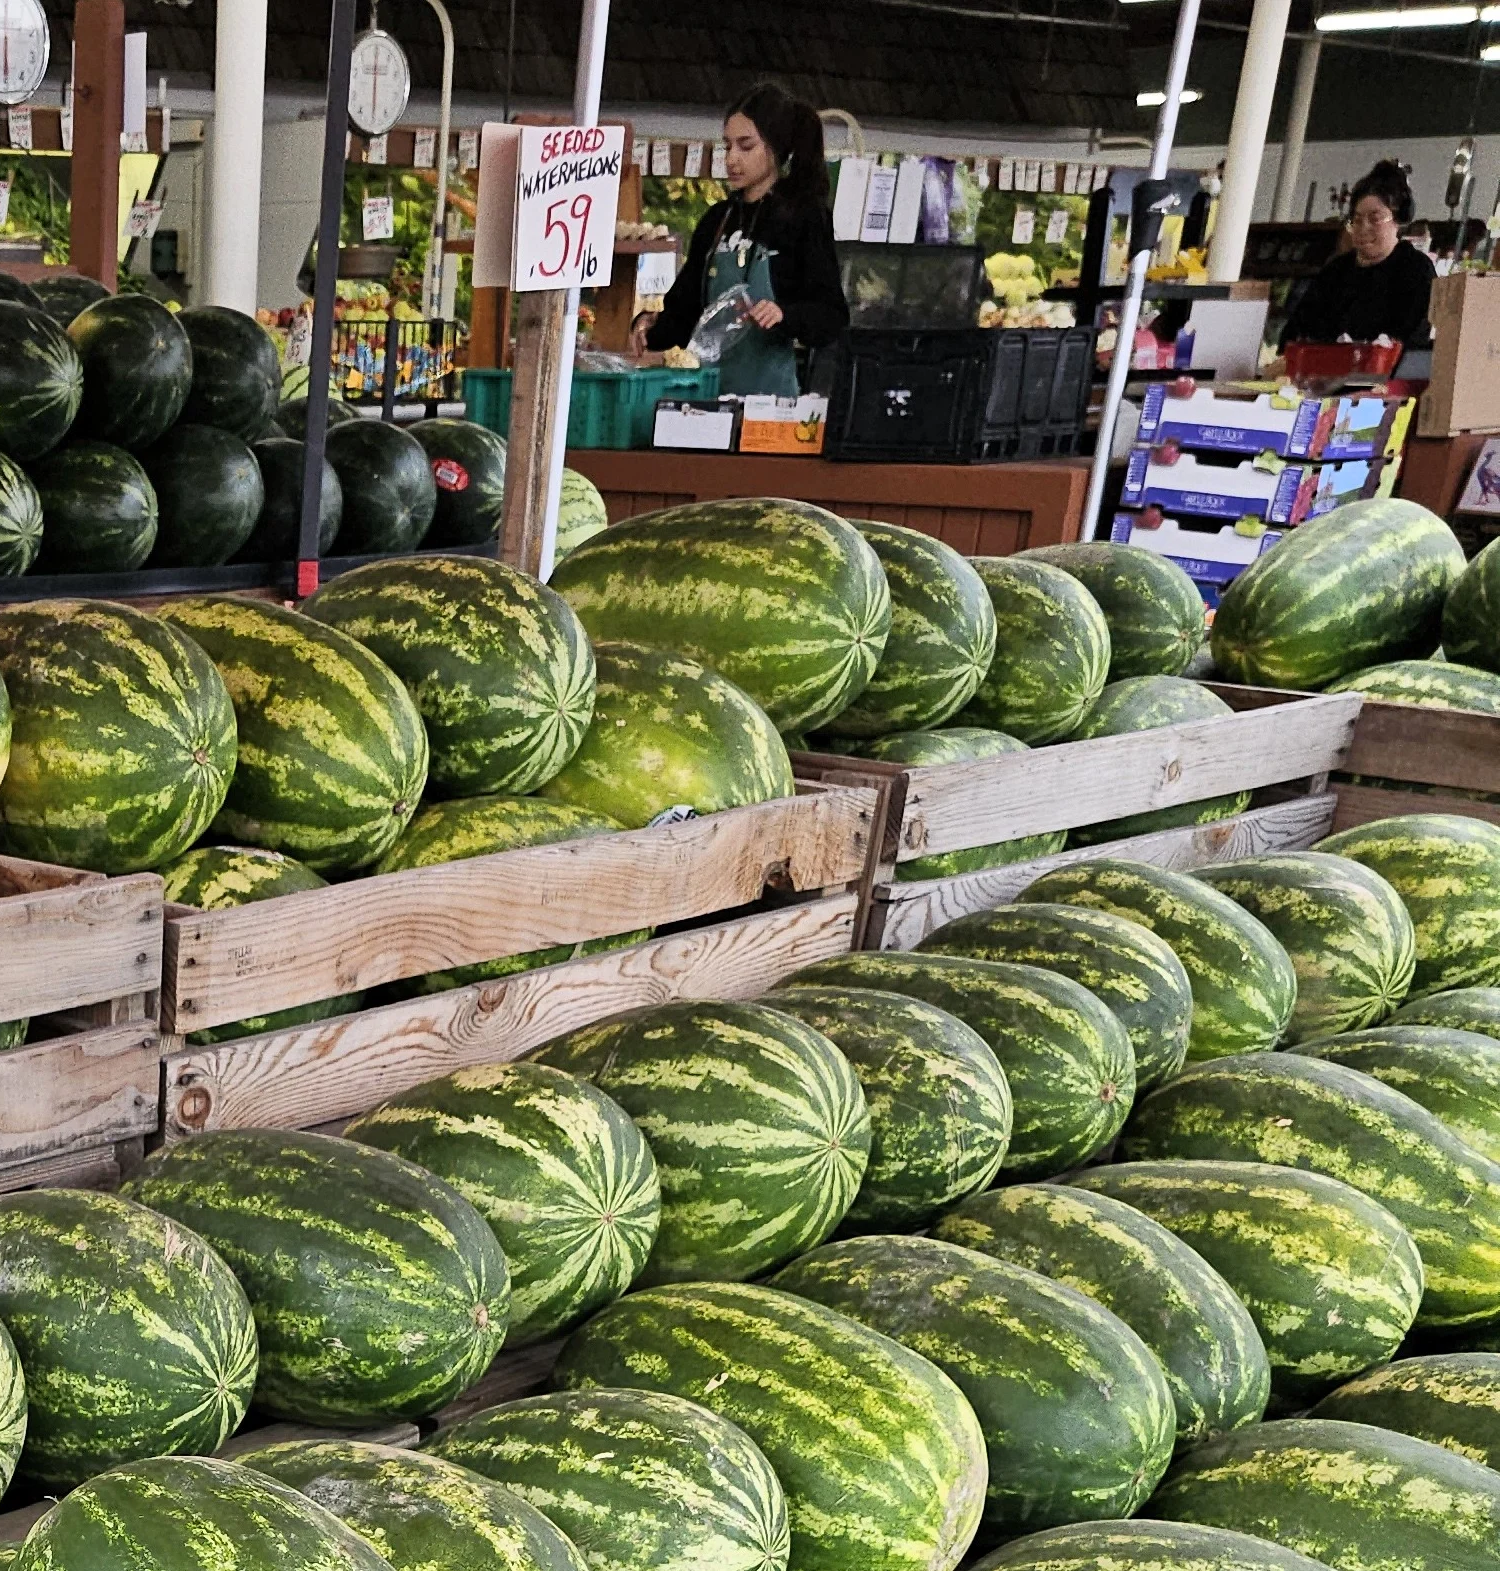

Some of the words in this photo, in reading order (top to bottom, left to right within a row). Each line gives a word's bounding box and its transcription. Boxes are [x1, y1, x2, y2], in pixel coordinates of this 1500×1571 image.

[540, 128, 605, 164] SEEDED
[520, 150, 621, 201] WATERMELONS
[580, 242, 598, 284] lb
